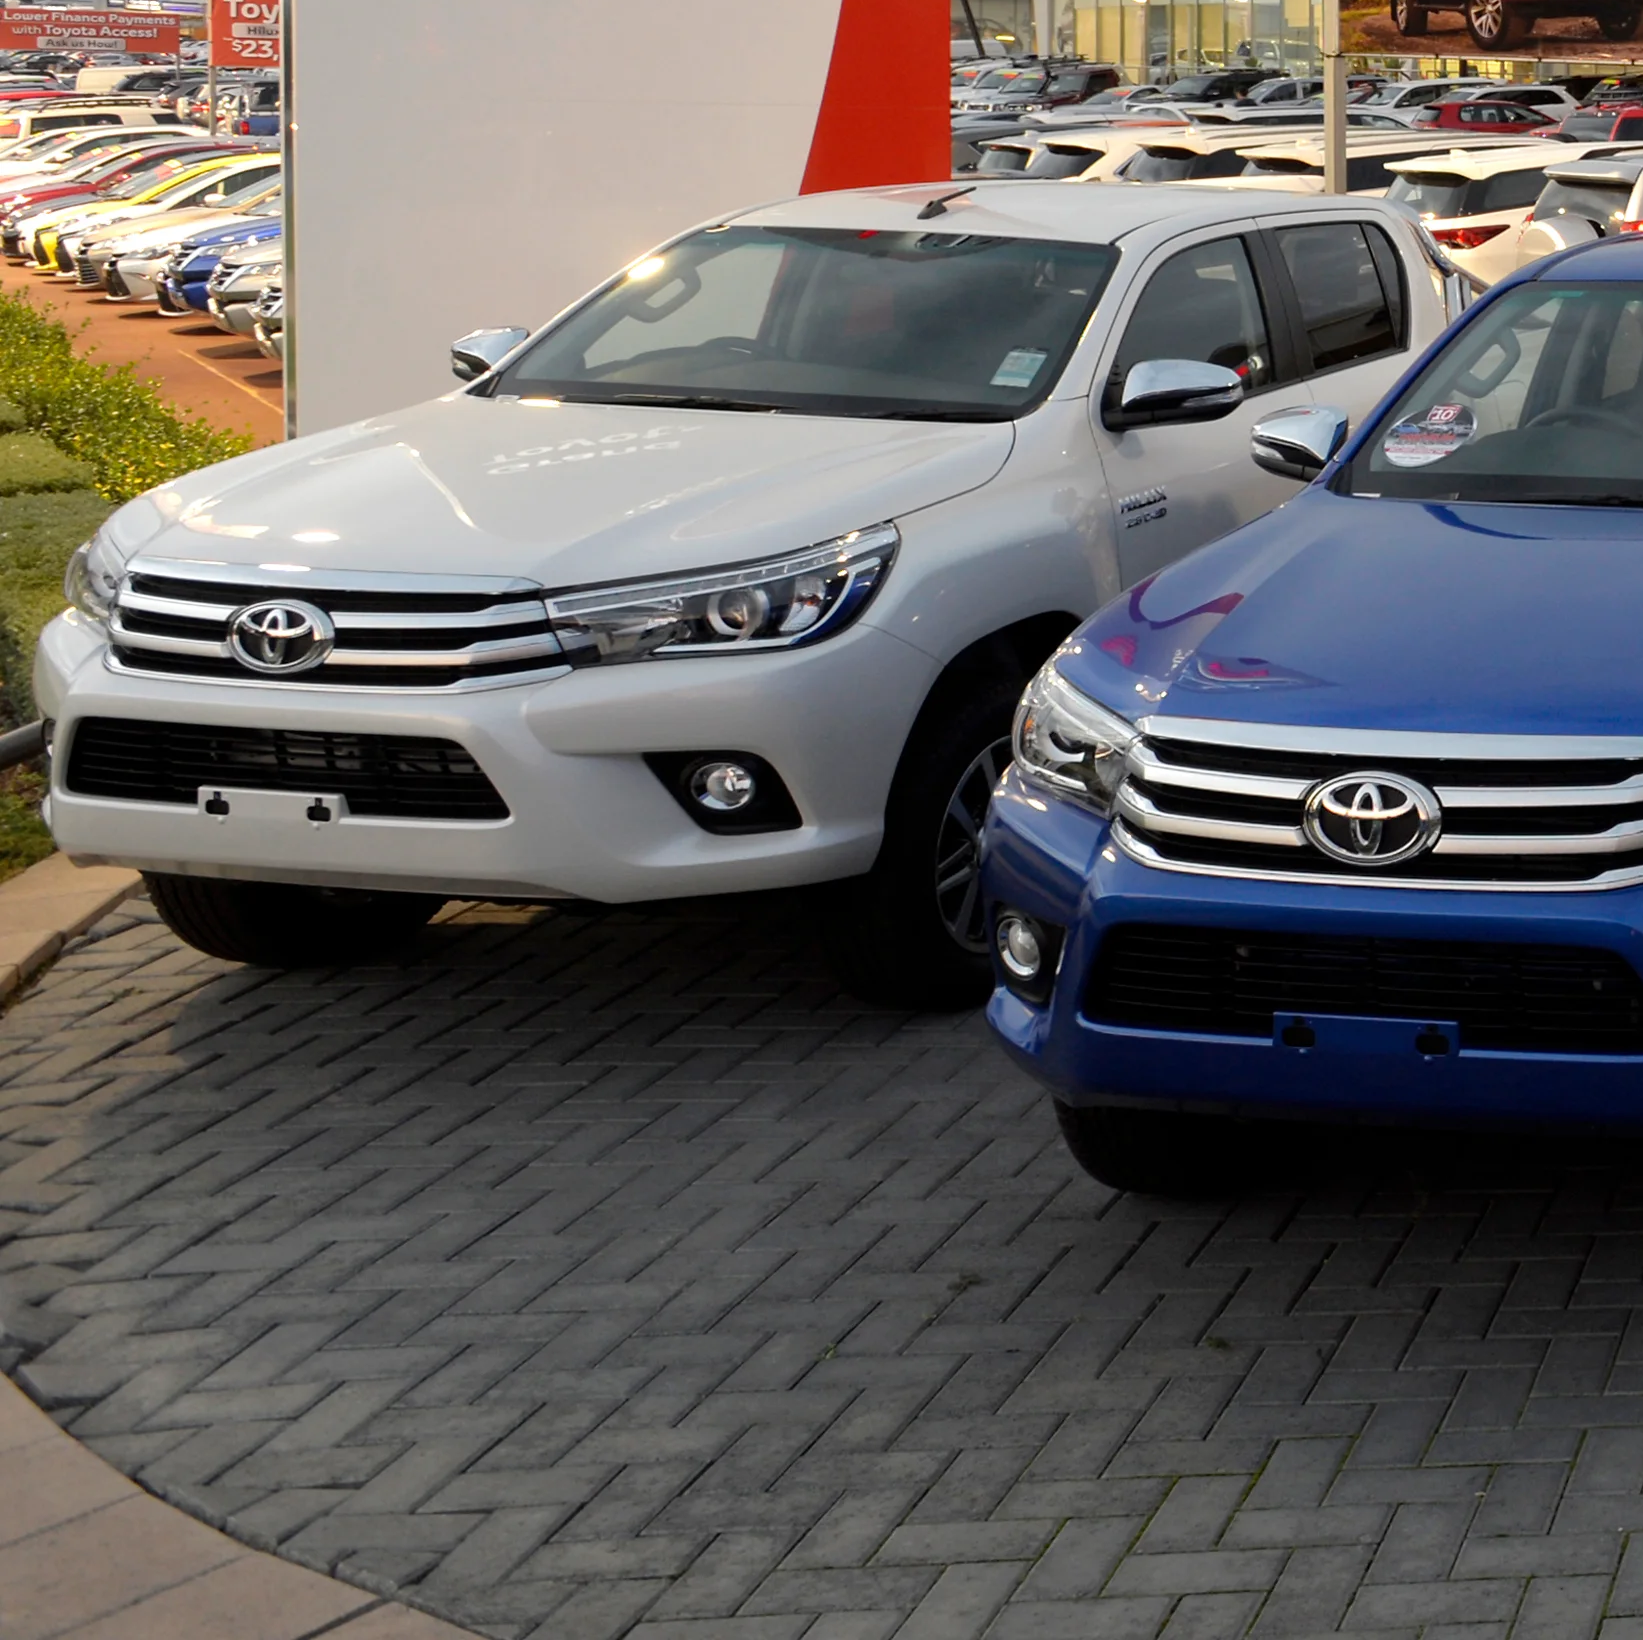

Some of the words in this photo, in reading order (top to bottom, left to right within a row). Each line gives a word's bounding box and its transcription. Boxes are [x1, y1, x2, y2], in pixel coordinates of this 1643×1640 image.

[3, 10, 49, 21] Lower
[51, 12, 106, 23] Finance
[108, 13, 176, 26] Payments
[12, 25, 42, 35] with
[44, 24, 97, 37] Toyota
[99, 26, 158, 38] Access!
[45, 39, 68, 48] Ask
[88, 41, 118, 49] How!
